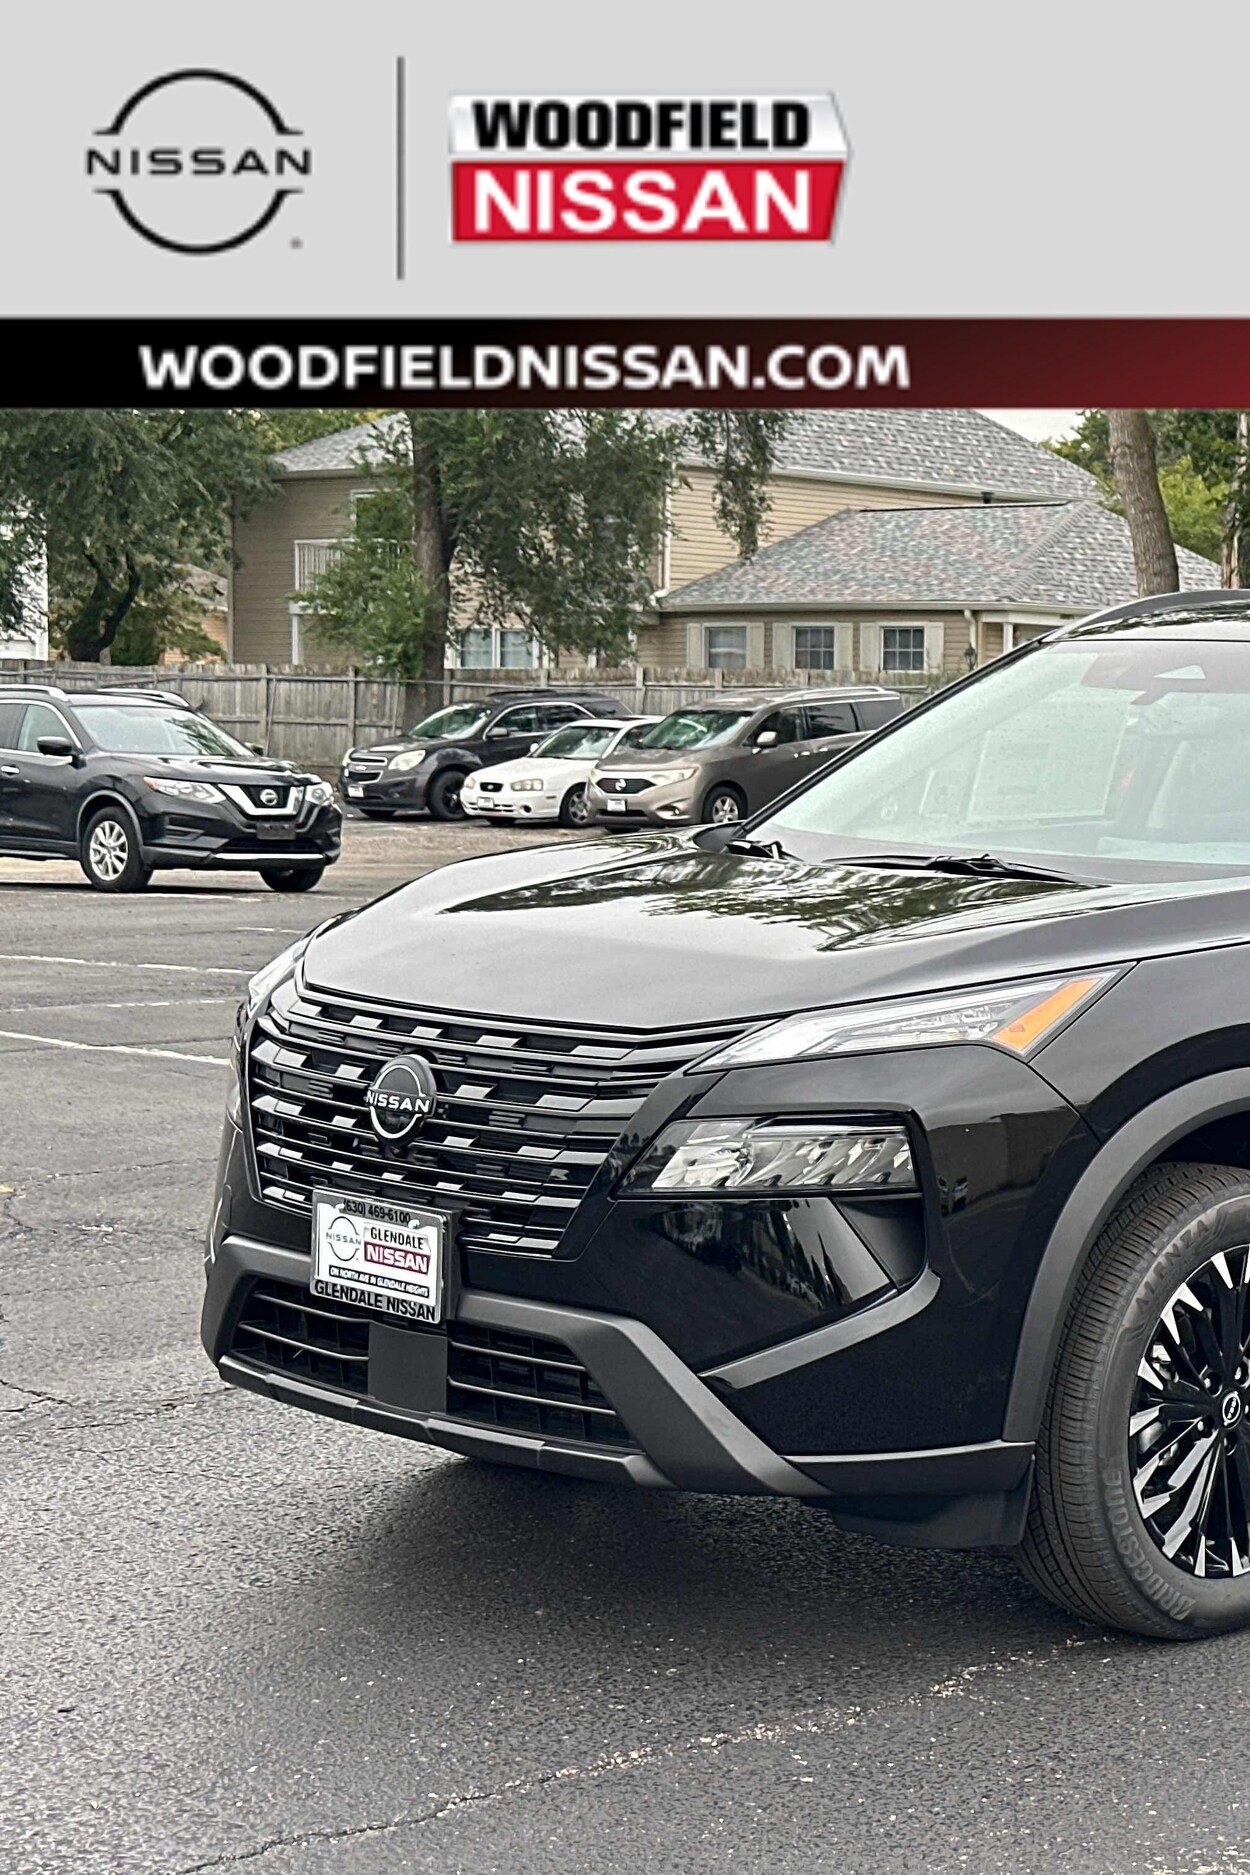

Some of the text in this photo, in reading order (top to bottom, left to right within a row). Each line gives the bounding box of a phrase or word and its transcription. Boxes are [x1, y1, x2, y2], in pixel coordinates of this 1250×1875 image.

[366, 1090, 430, 1112] NISSAN
[343, 1199, 412, 1224] (630) 469-6100
[326, 1232, 361, 1245] NISSAN
[370, 1226, 424, 1250] GLENDALE
[366, 1244, 428, 1273] NISSAN
[314, 1280, 436, 1322] GLENDALE NISSAN
[1102, 1469, 1197, 1622] BRIDGESTONE
